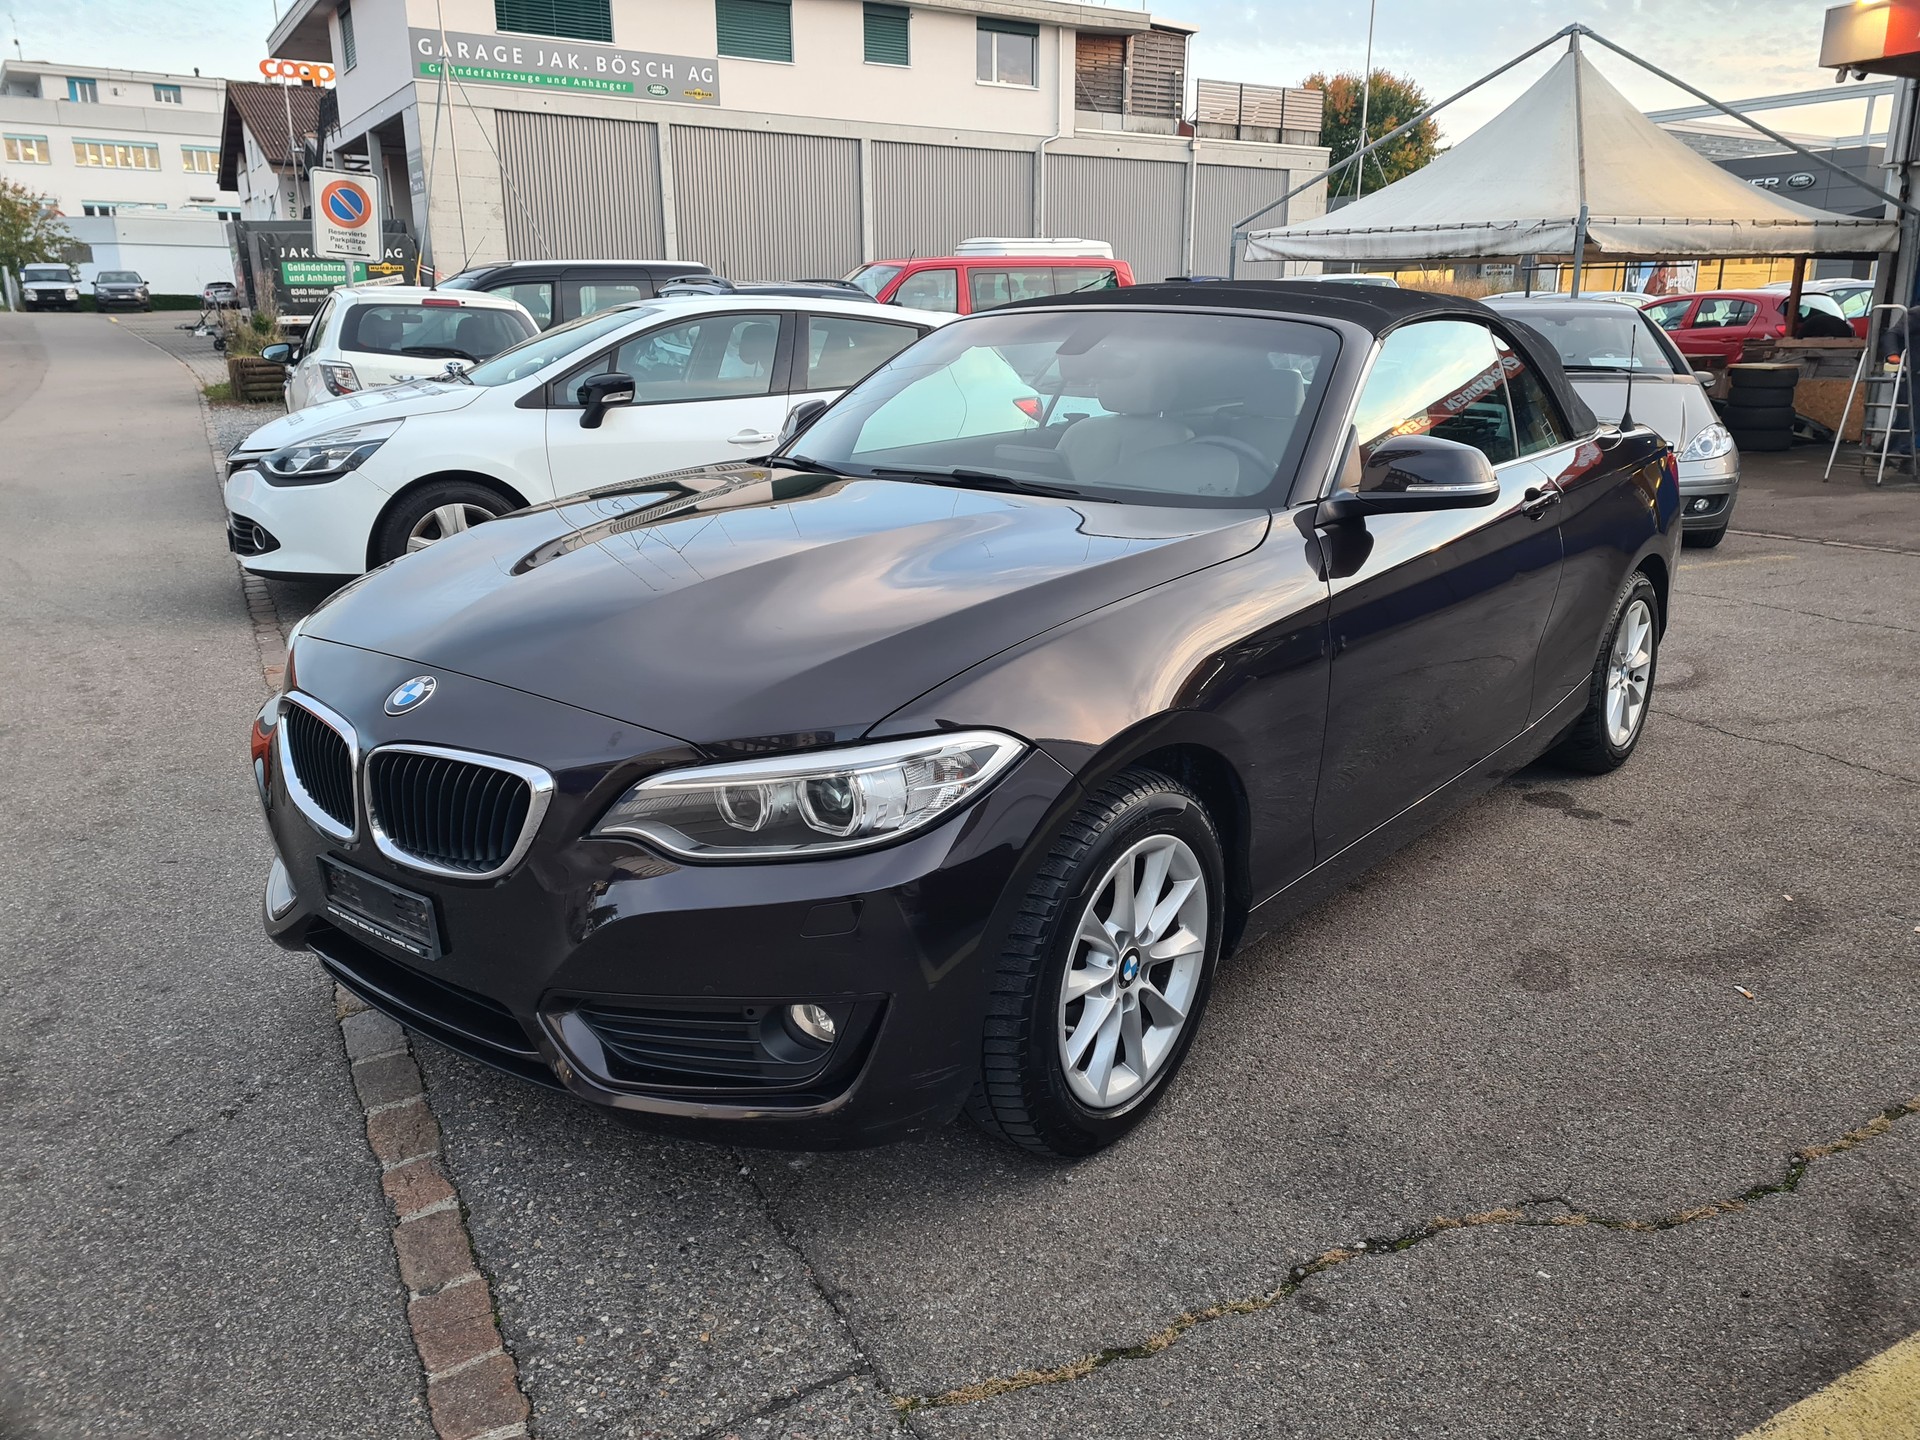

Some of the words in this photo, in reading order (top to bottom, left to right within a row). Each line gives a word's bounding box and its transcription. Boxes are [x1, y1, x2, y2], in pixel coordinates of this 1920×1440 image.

[417, 38, 522, 64] GARAGE
[537, 50, 588, 71] JAK.
[596, 54, 674, 80] BÖSCH
[687, 66, 714, 83] AG
[259, 59, 336, 87] coop
[428, 64, 540, 83] Gändefahrzeuge
[546, 76, 567, 85] und
[573, 77, 627, 91] Anhänger
[1748, 177, 1780, 188] ER
[289, 206, 297, 220] CH
[328, 228, 367, 238] Reservierte
[330, 235, 366, 245] Parkplätze
[280, 247, 315, 258] JAK.
[384, 248, 403, 258] AG
[289, 274, 305, 282] und
[307, 274, 346, 283] Anhänger
